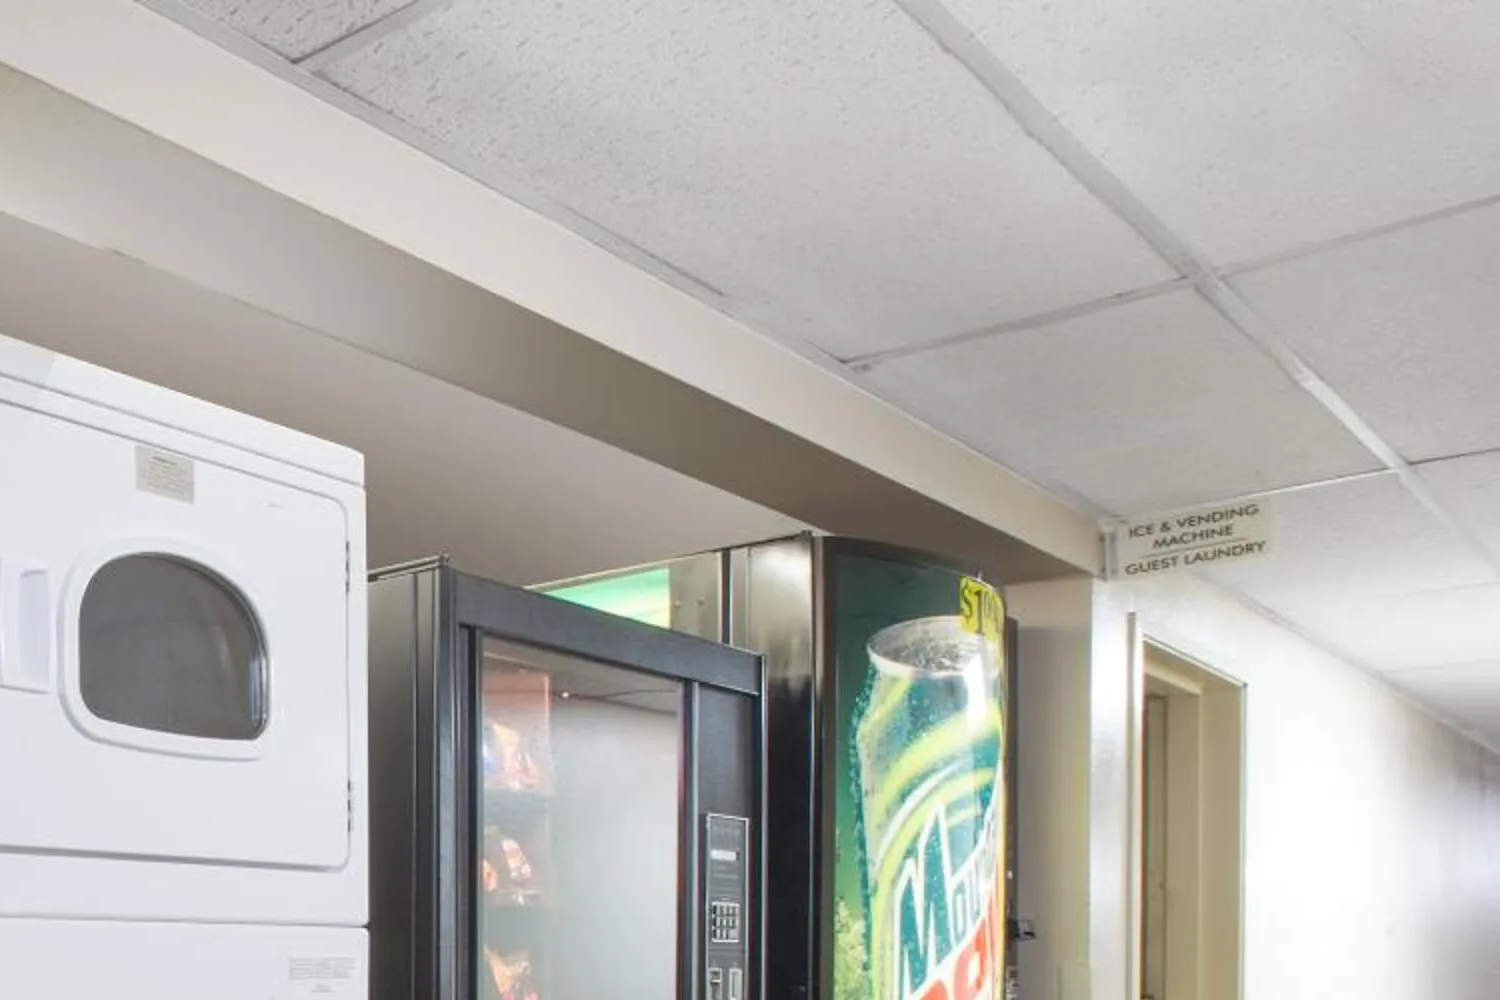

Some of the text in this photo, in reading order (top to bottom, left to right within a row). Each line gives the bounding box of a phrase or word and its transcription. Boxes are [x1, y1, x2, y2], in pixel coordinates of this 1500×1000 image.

[1129, 503, 1261, 538] ICE & VENDING
[1153, 524, 1233, 549] MACHINE
[1125, 540, 1266, 576] GUEST LAUNDRY
